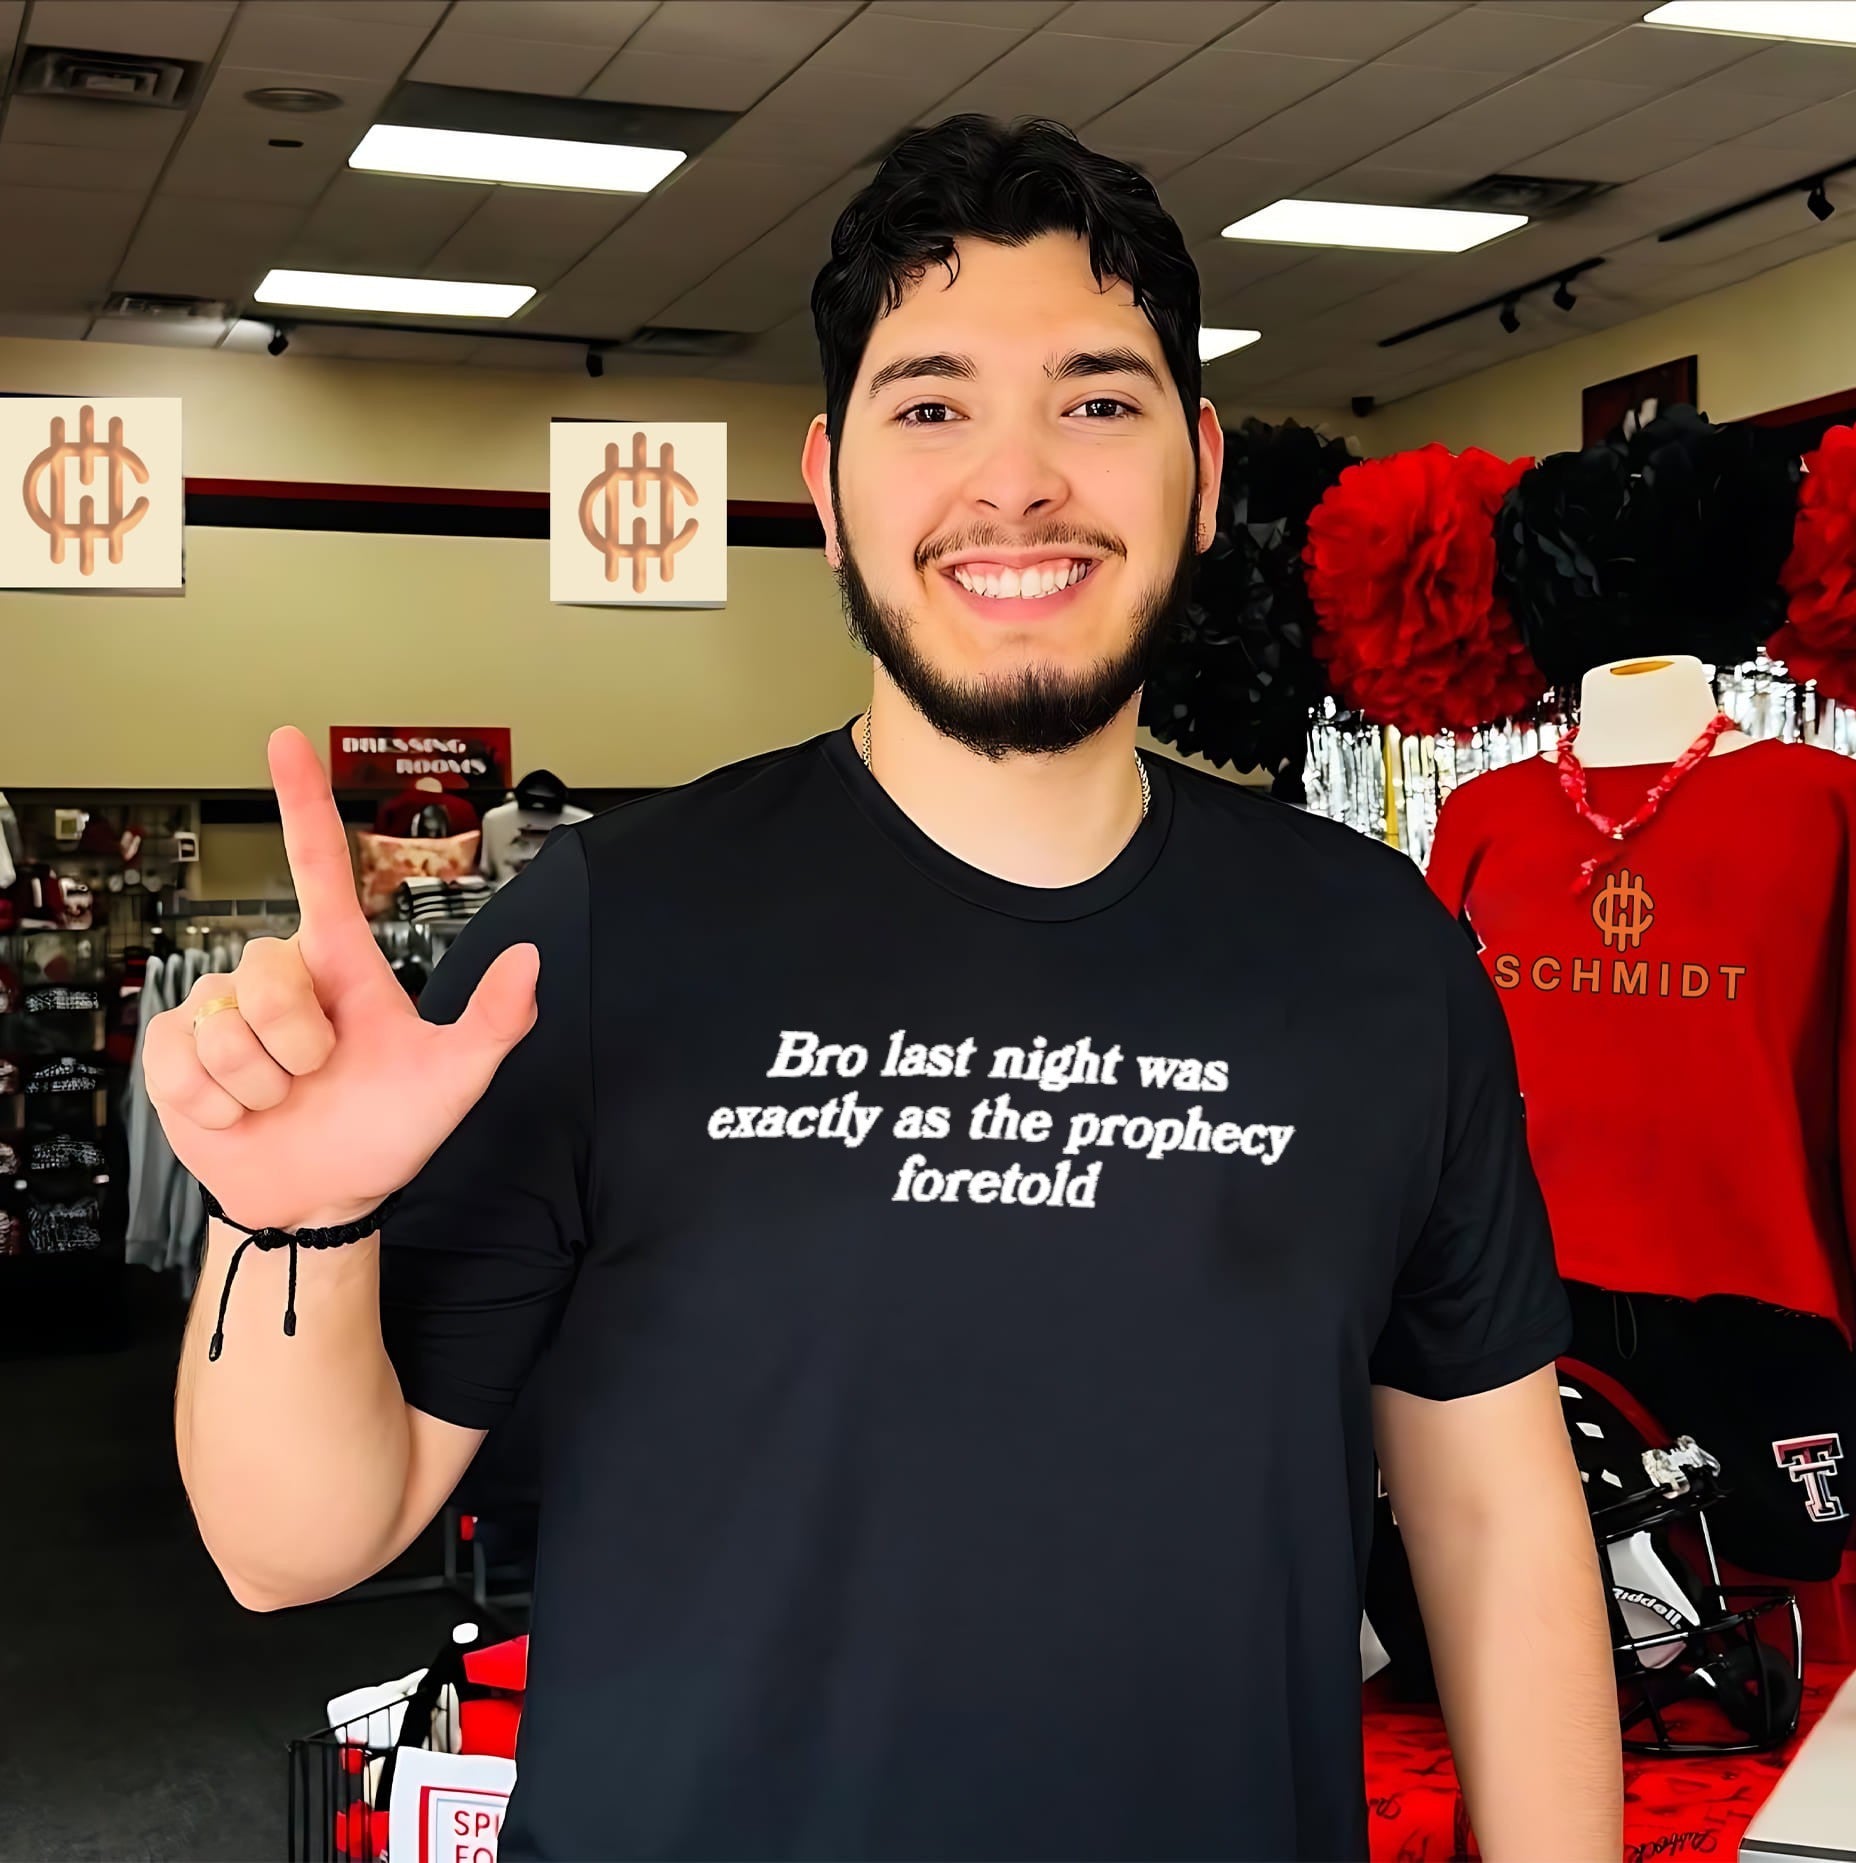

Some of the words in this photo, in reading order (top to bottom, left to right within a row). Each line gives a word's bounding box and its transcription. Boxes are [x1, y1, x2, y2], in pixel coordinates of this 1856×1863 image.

[341, 737, 467, 754] DRESSING
[396, 758, 487, 775] ROOMS
[1494, 954, 1747, 1001] SCHMIDT
[766, 1030, 868, 1078] Bro
[880, 1030, 977, 1077] last
[988, 1036, 1124, 1092] night
[1137, 1053, 1229, 1092] was
[708, 1091, 883, 1148] exactly
[893, 1105, 951, 1140] as
[969, 1093, 1053, 1143] the
[1063, 1105, 1296, 1165] prophecy
[891, 1153, 1103, 1208] foretold
